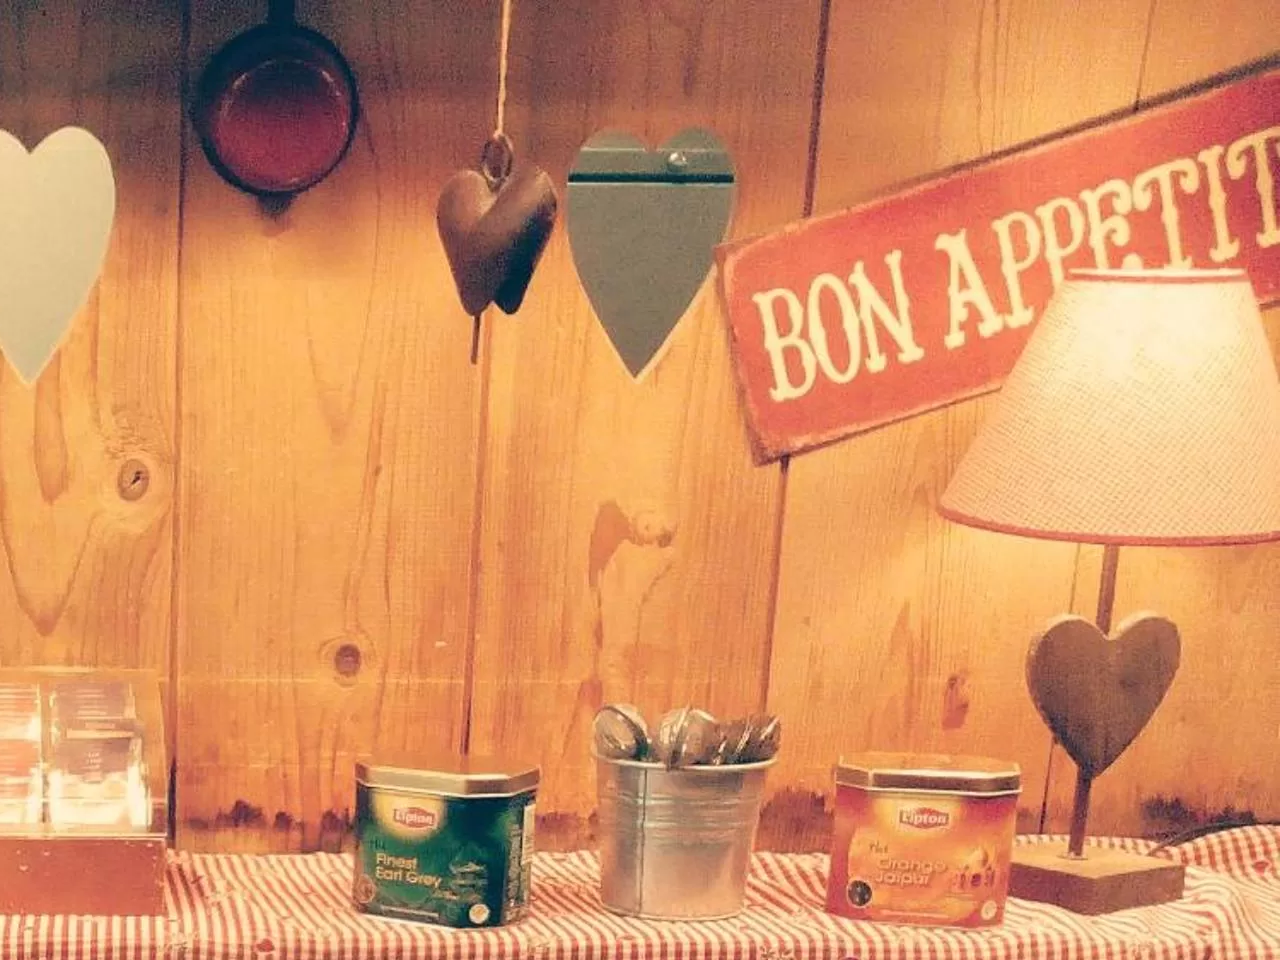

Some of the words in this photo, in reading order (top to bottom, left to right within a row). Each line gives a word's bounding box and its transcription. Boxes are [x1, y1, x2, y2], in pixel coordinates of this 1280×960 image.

[752, 249, 925, 403] BON
[934, 126, 1280, 350] APPETIT
[395, 810, 435, 827] Lipton
[900, 809, 948, 826] Lipton
[375, 852, 418, 870] Finest
[375, 866, 403, 881] Earl
[405, 871, 443, 889] Grey
[875, 870, 929, 887] Jaipur
